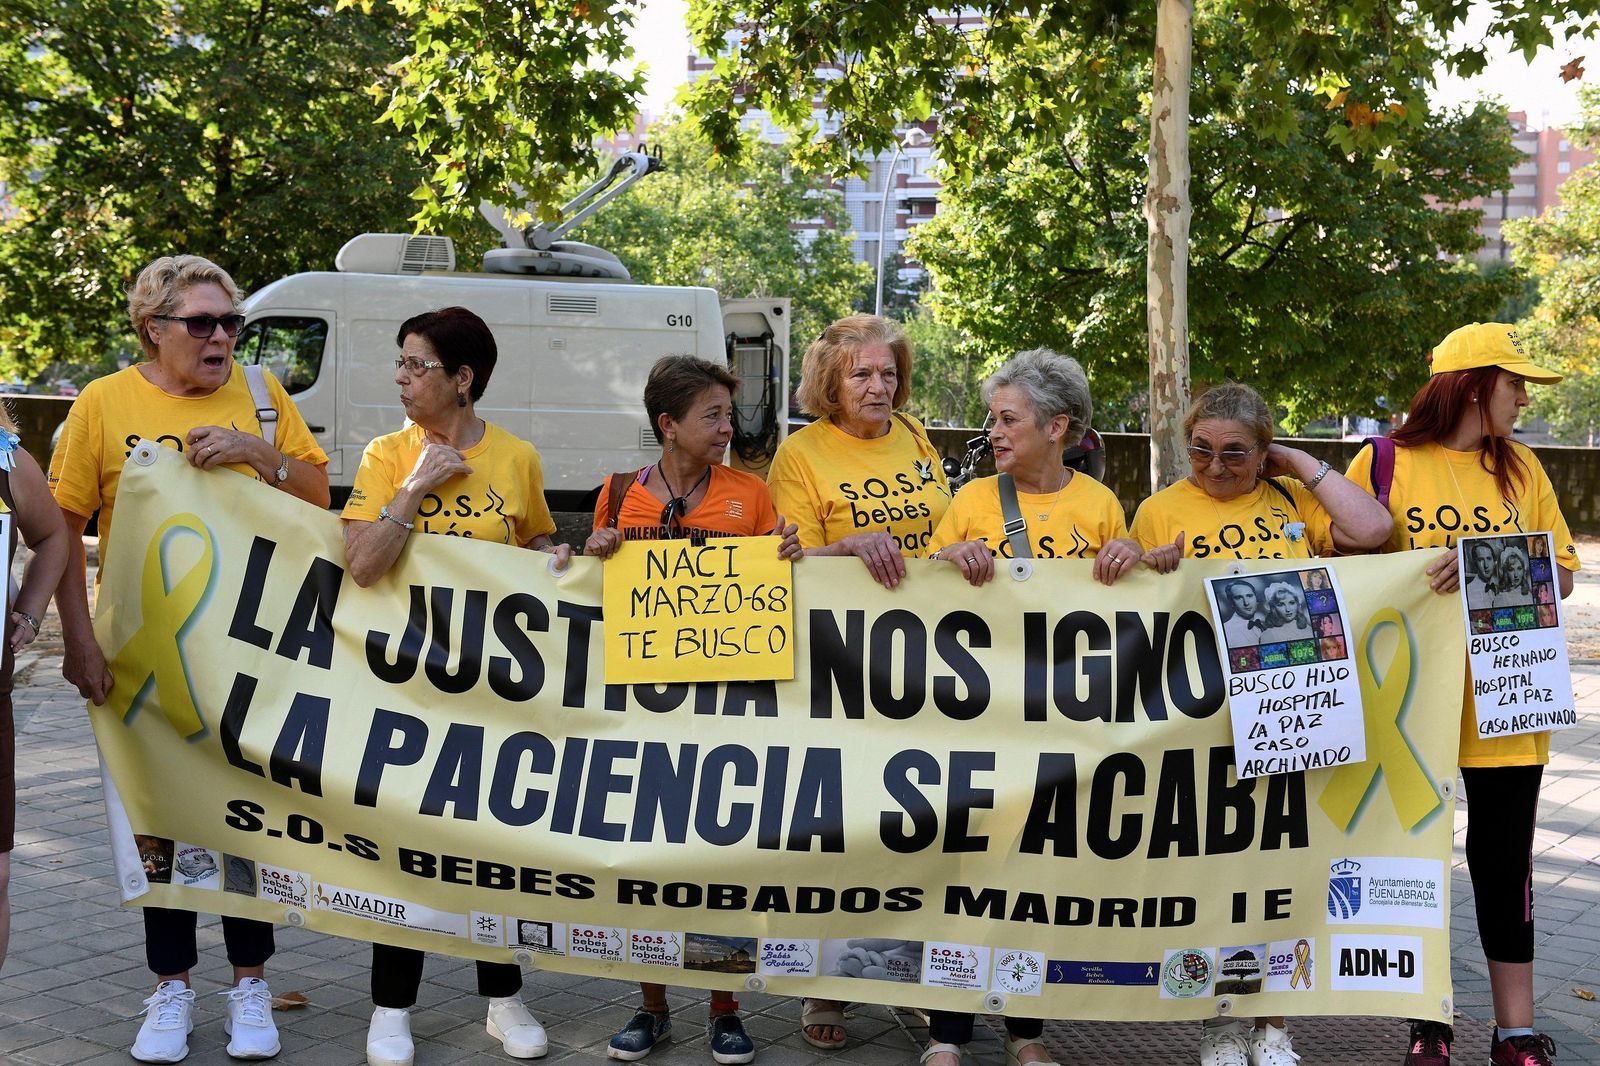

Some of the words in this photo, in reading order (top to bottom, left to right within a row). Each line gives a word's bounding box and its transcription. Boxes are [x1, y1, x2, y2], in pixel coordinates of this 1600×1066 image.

[666, 314, 692, 327] G10
[839, 473, 923, 500] S.O.S.
[850, 499, 931, 528] bebés
[1406, 504, 1500, 534] S.O.S.
[1192, 516, 1280, 558] S.O.S.
[646, 546, 740, 580] NACI
[630, 582, 788, 618] MARZO-68
[228, 536, 344, 670] LA
[366, 584, 778, 718] JUST
[809, 609, 992, 720] NOS
[618, 630, 658, 658] TE
[674, 625, 786, 658] BUSCO
[1470, 634, 1520, 654] BUSCO
[1264, 654, 1286, 663] ABRIL
[1292, 648, 1314, 660] 1975
[1230, 670, 1296, 696] BUSCO
[1474, 671, 1534, 696] HOSPITAL
[1258, 688, 1344, 714] HOSPITAL
[1498, 692, 1518, 706] LA
[1524, 688, 1554, 704] PAZ
[1248, 722, 1268, 740] LA
[1278, 713, 1322, 734] PAZ
[1479, 718, 1508, 734] CASO
[1512, 708, 1576, 732] ARCHIVADO
[1254, 736, 1309, 750] CASO
[220, 672, 332, 798] LA
[354, 708, 846, 853] PACIENCIA
[880, 748, 996, 854] SE
[1019, 746, 1310, 860] ACABA
[225, 800, 380, 862] S.O.S
[399, 847, 595, 900] BEBES
[616, 878, 924, 914] ROBADOS
[944, 886, 1197, 928] MADRID
[1232, 892, 1246, 923] I
[1264, 888, 1292, 922] E
[261, 868, 294, 884] S.O.S.
[1368, 877, 1424, 888] Ayuntamiento
[1426, 880, 1436, 890] de
[263, 886, 306, 903] robados
[1368, 888, 1436, 900] FUENLABRADA
[332, 892, 406, 920] ANADIR
[1424, 900, 1438, 908] Social
[572, 928, 608, 940] S.O.S.
[572, 937, 607, 948] bebés
[632, 934, 666, 944] S.O.S.
[572, 946, 620, 956] robados
[632, 942, 666, 953] bebés
[763, 943, 798, 952] S.O.S.
[931, 948, 965, 958] S.O.S.
[632, 951, 678, 962] robados
[930, 956, 964, 966] bebés
[1268, 954, 1294, 964] SOS
[1338, 948, 1415, 978] ADN-D
[886, 970, 918, 979] robados
[930, 964, 975, 974] robados
